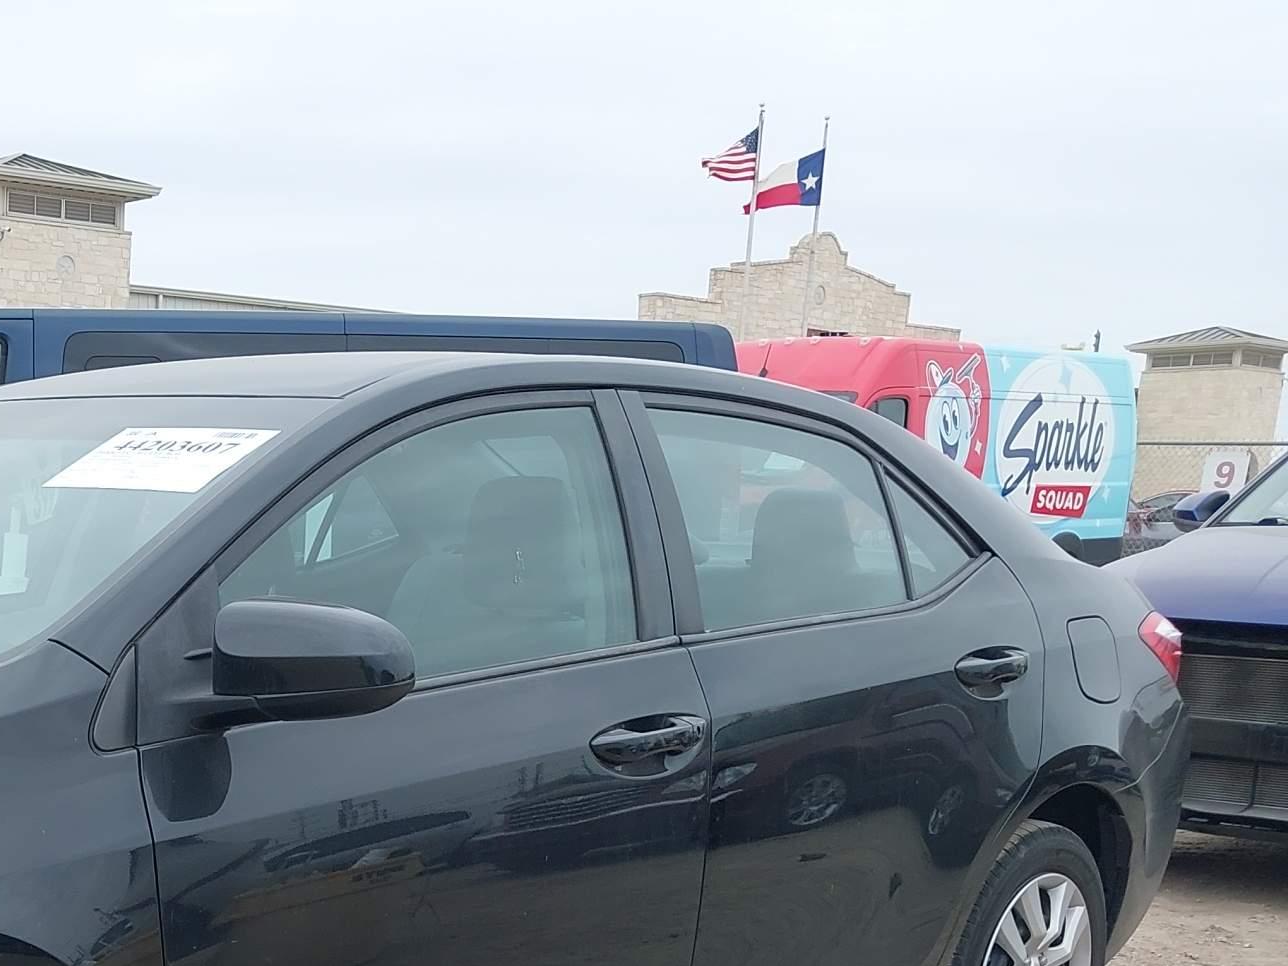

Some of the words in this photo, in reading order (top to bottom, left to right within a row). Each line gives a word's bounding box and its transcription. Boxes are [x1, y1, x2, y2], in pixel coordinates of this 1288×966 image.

[114, 440, 241, 454] 44203607
[1001, 392, 1104, 497] Sparkle
[1214, 461, 1235, 489] 9
[1036, 489, 1084, 511] SQUAD
